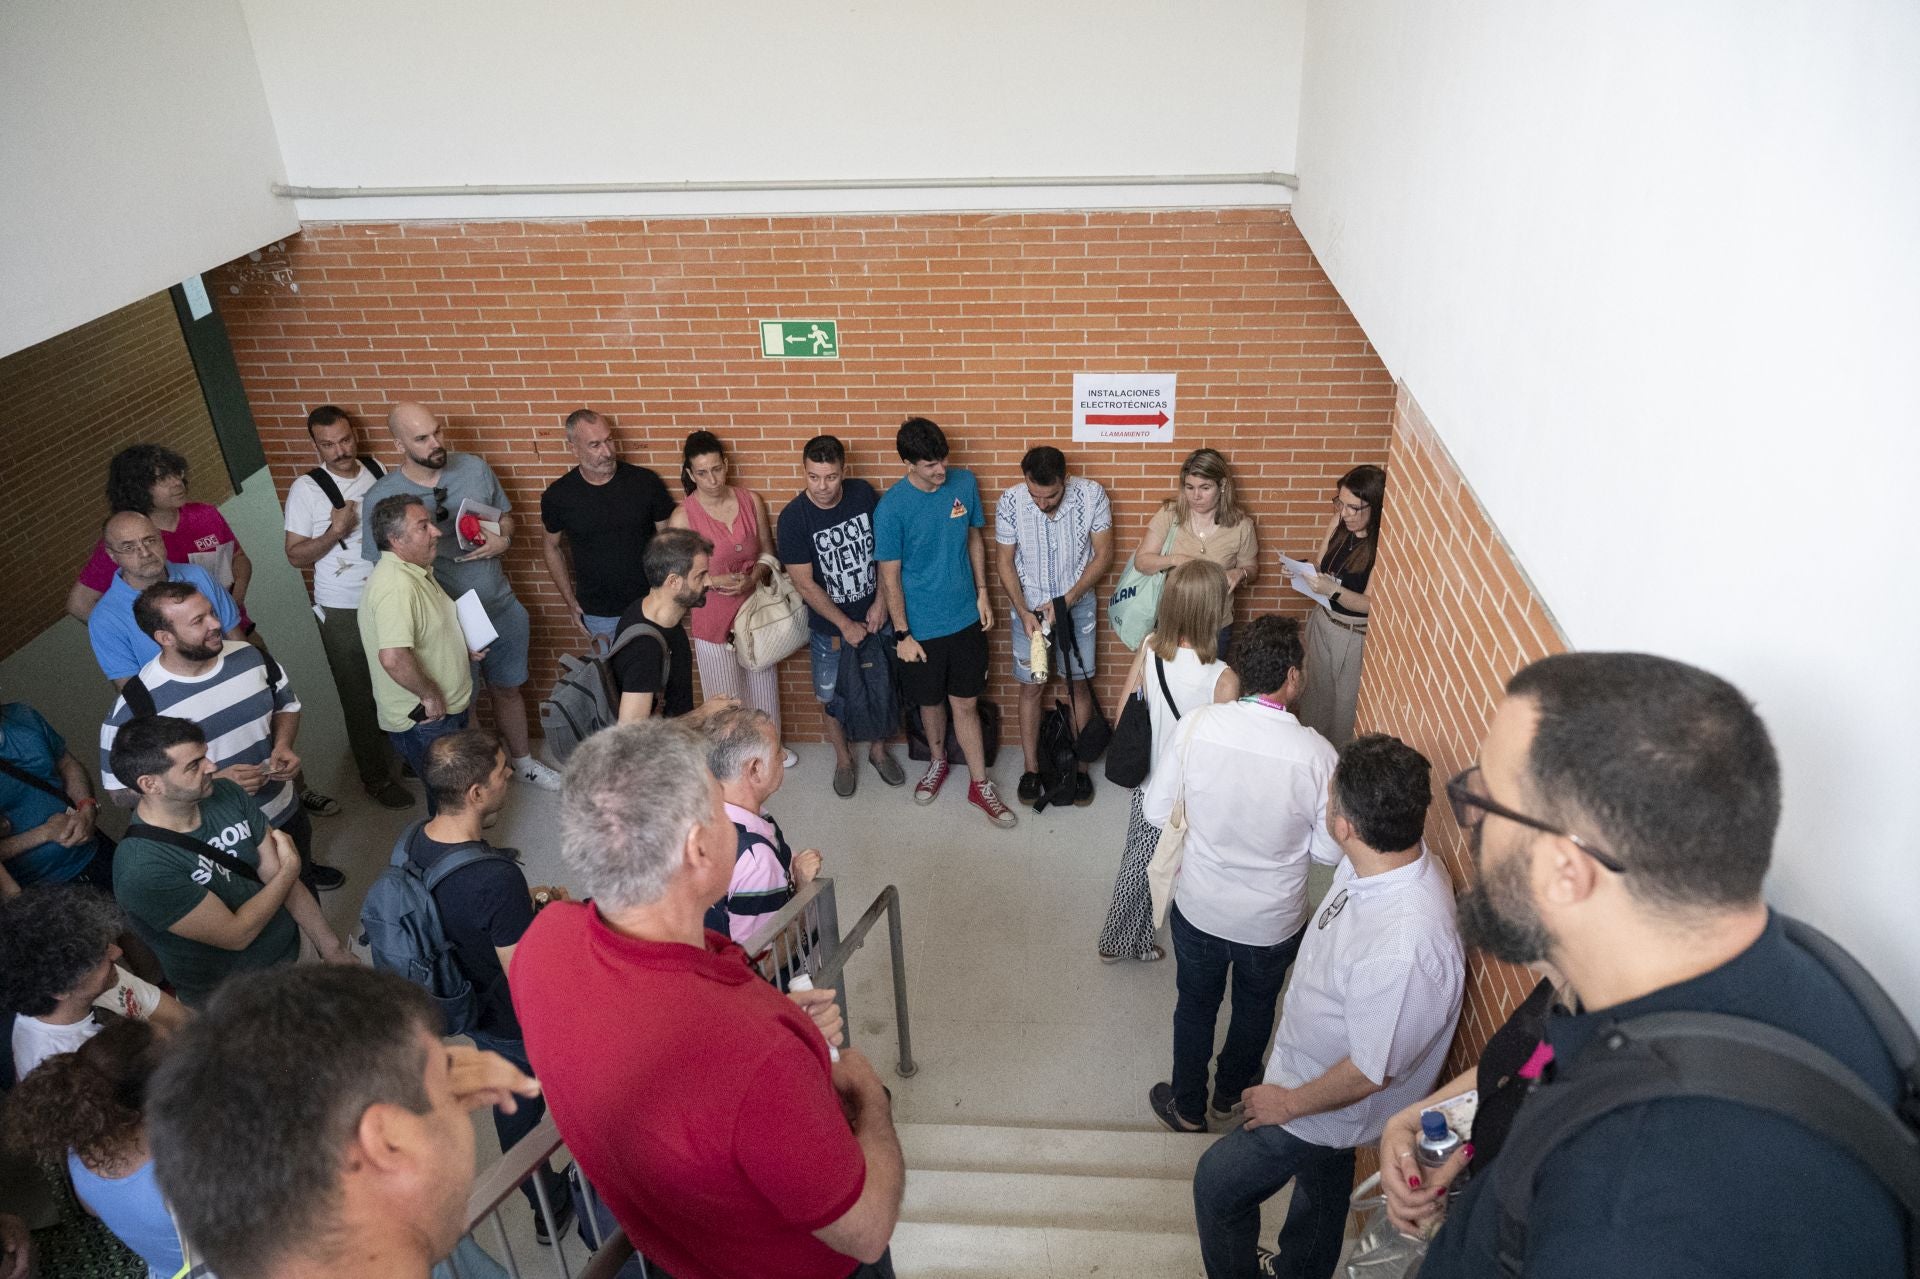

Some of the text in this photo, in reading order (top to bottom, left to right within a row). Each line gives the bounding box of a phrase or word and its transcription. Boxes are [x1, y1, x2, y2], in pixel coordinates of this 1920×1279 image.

[1088, 389, 1160, 397] INSTALACIONES
[1080, 400, 1168, 409] ELECTROTÉCNICAS
[815, 517, 872, 552] COOL
